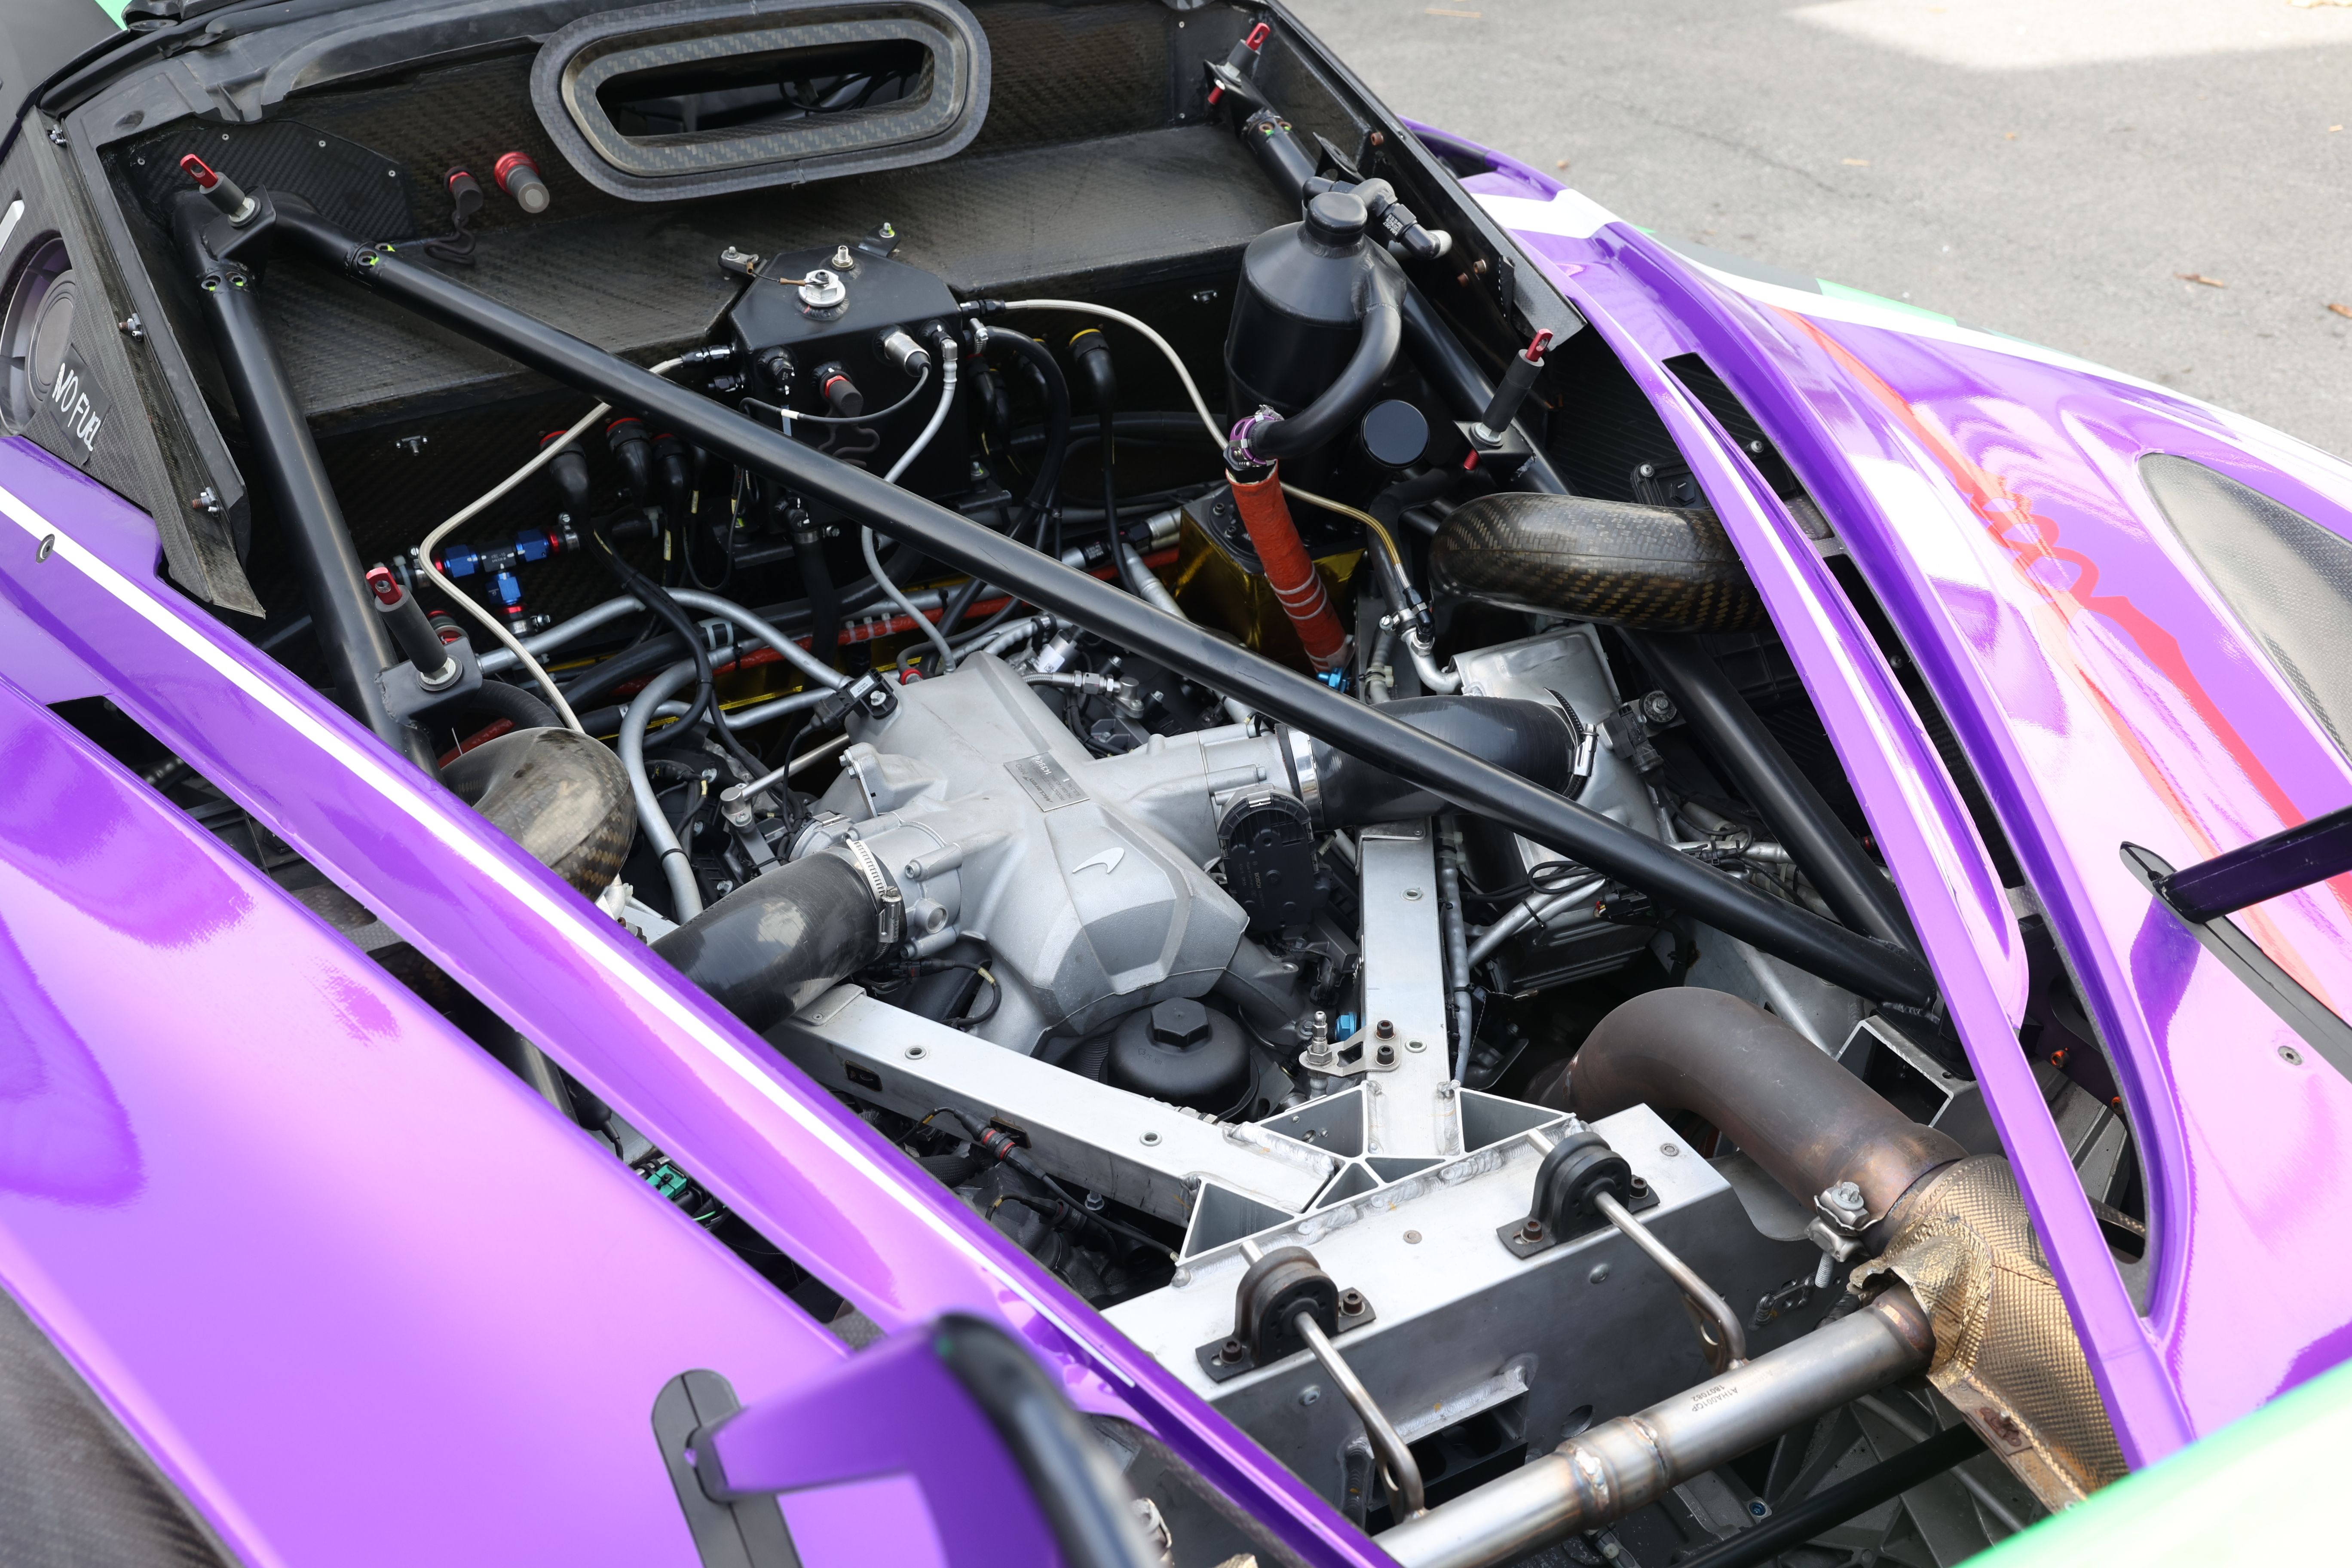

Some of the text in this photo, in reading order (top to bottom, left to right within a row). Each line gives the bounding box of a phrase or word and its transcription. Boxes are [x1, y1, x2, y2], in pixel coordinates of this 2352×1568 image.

[52, 362, 101, 452] NO FUEL
[1029, 778, 1053, 803] McLaren
[1048, 782, 1065, 800] PRODUCTION
[1071, 787, 1081, 796] BUILD
[1692, 1384, 1725, 1402] 1807082
[1692, 1387, 1738, 1412] A1HA001QP
